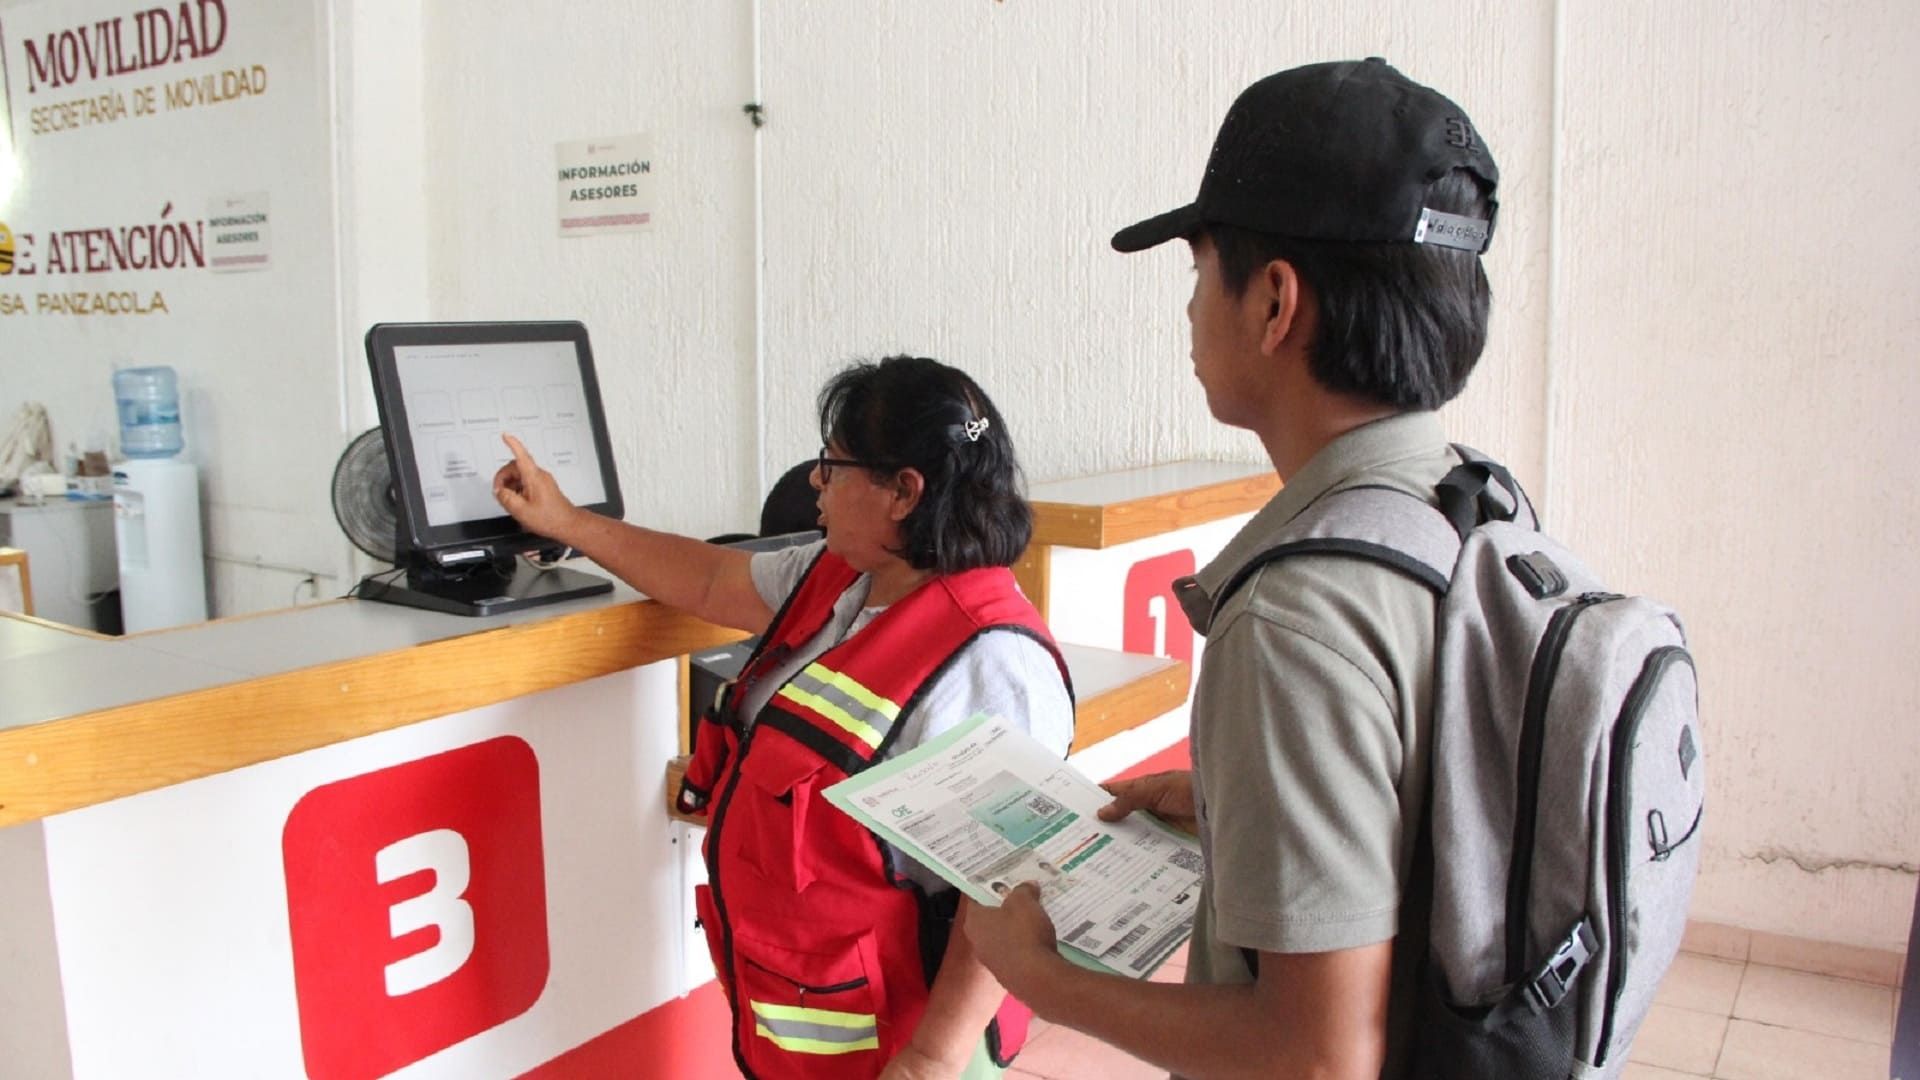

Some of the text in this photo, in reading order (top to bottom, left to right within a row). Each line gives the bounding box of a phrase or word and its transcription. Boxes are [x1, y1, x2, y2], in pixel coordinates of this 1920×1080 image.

[24, 0, 228, 93] MOVILIDAD
[134, 87, 156, 116] DE
[165, 65, 267, 112] MOVILIDAD
[558, 159, 650, 181] INFORMACIÓN
[570, 184, 638, 201] ASESORES
[47, 202, 206, 275] ATENCIÓN
[216, 231, 259, 244] ASESORES
[37, 291, 169, 315] PANZACOLA
[1147, 595, 1171, 659] 1
[375, 828, 475, 997] 3
